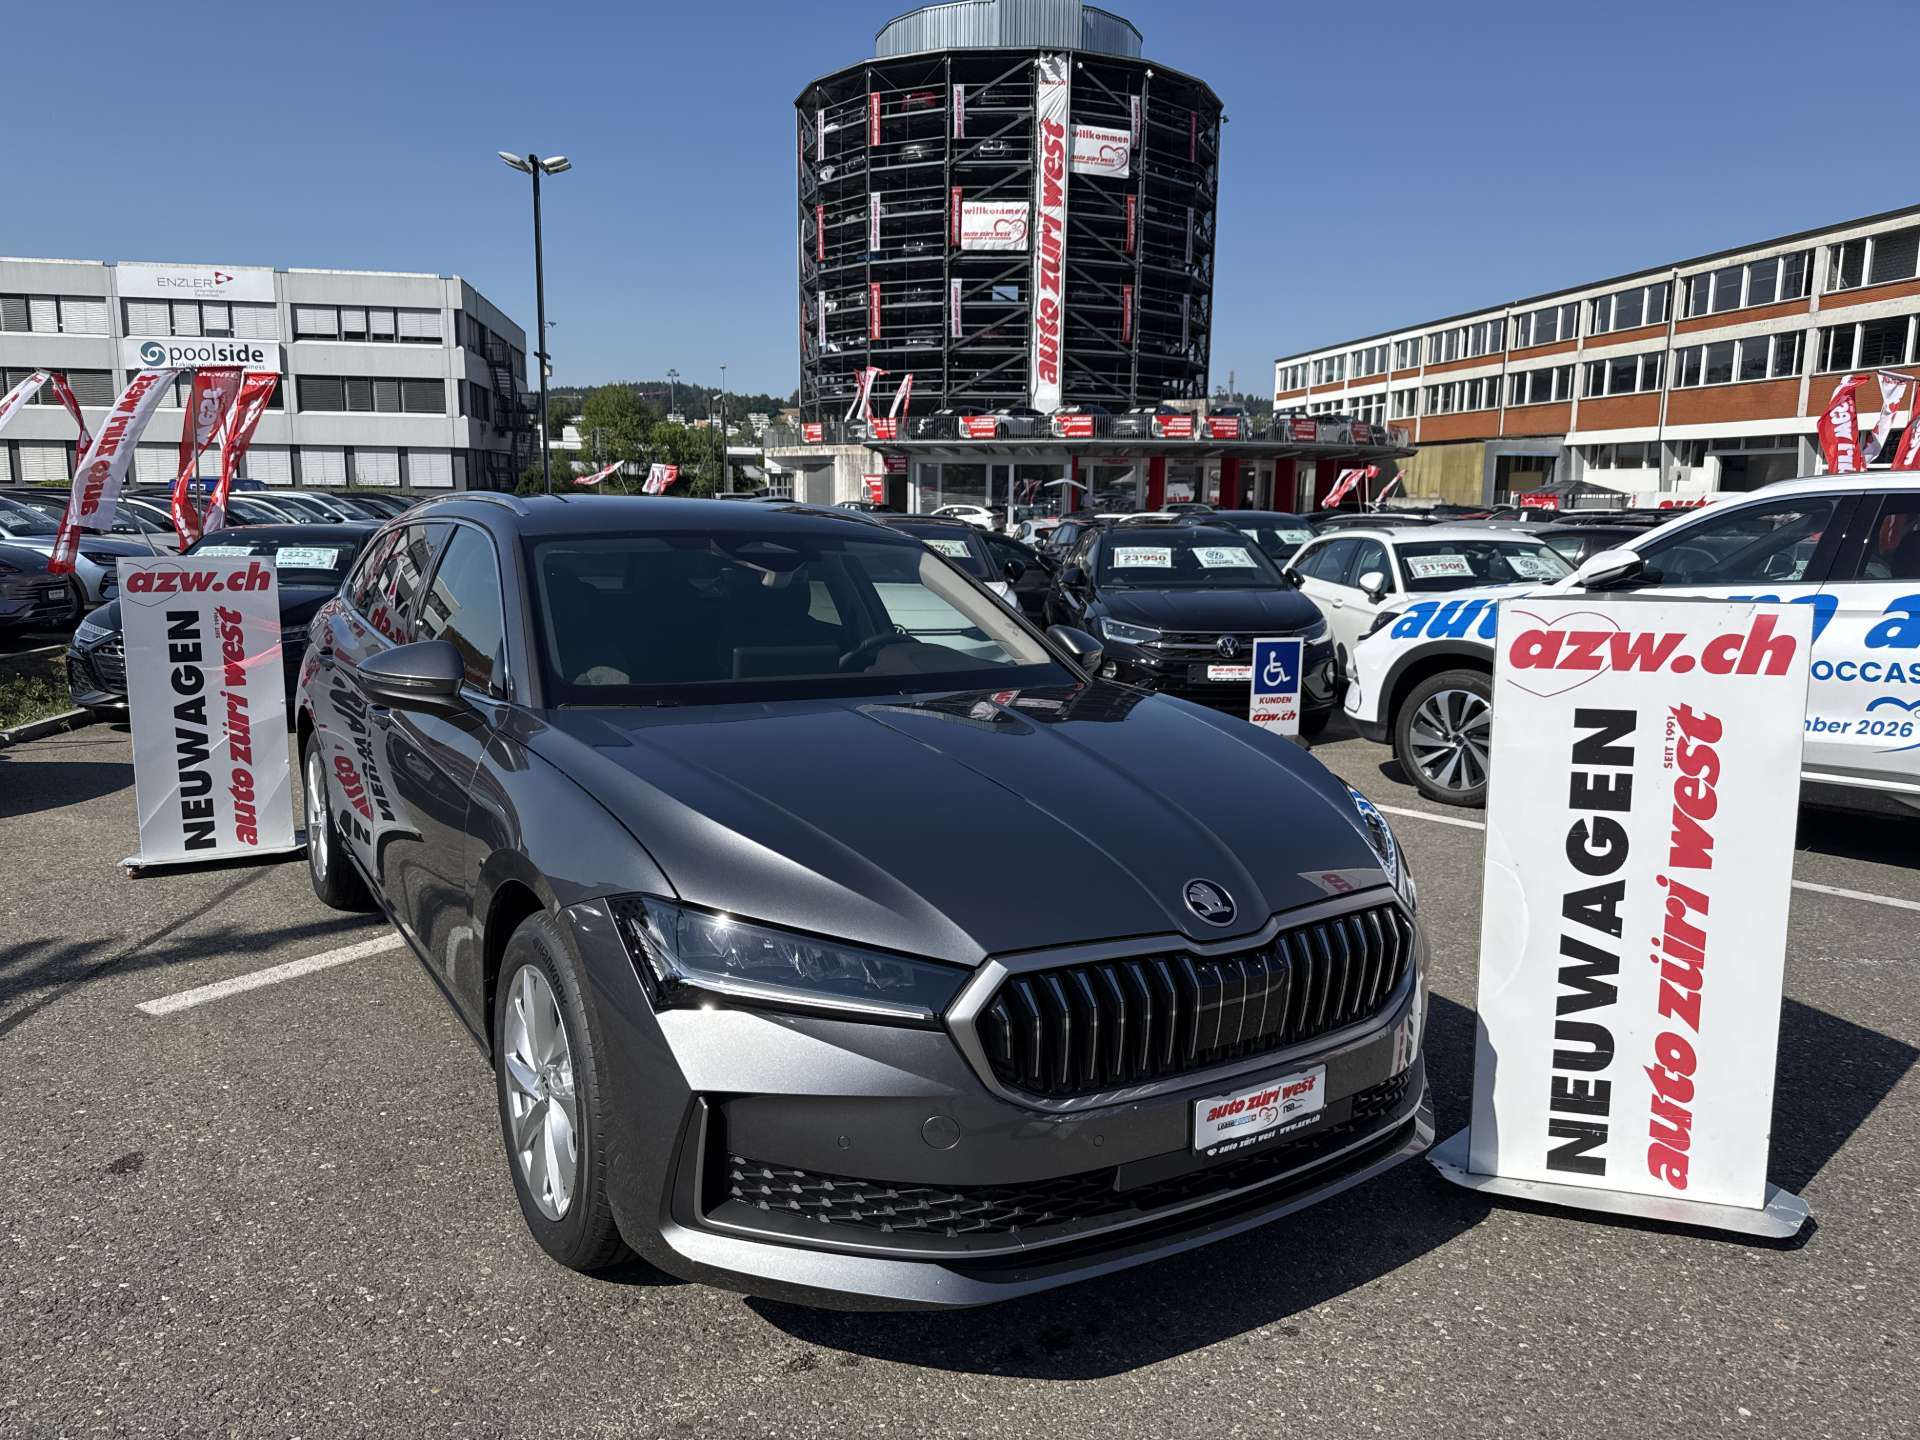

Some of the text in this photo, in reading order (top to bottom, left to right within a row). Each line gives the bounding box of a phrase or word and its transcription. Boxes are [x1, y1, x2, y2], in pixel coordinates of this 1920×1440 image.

[1072, 130, 1129, 144] willkommen
[1042, 117, 1065, 208] west
[964, 206, 1027, 216] willkommen
[157, 277, 213, 288] ENZLER
[169, 343, 264, 366] poolside
[1036, 298, 1060, 386] auto
[126, 562, 271, 593] azw.ch
[1421, 562, 1465, 571] 31'500
[1509, 614, 1797, 677] azw.ch
[1252, 710, 1297, 722] azw.ch
[1258, 696, 1292, 705] KUNDEN
[166, 610, 217, 852] NEUWAGEN
[215, 605, 259, 846] auto züri west
[1856, 719, 1914, 738] 2026
[1664, 716, 1676, 769] SEIT 1991
[1546, 707, 1638, 1177] NEUWAGEN
[1642, 702, 1723, 1191] auto züri west
[1206, 1099, 1246, 1122] auto
[1246, 1085, 1282, 1110] züri
[1282, 1074, 1316, 1100] west
[1218, 1142, 1238, 1154] auto
